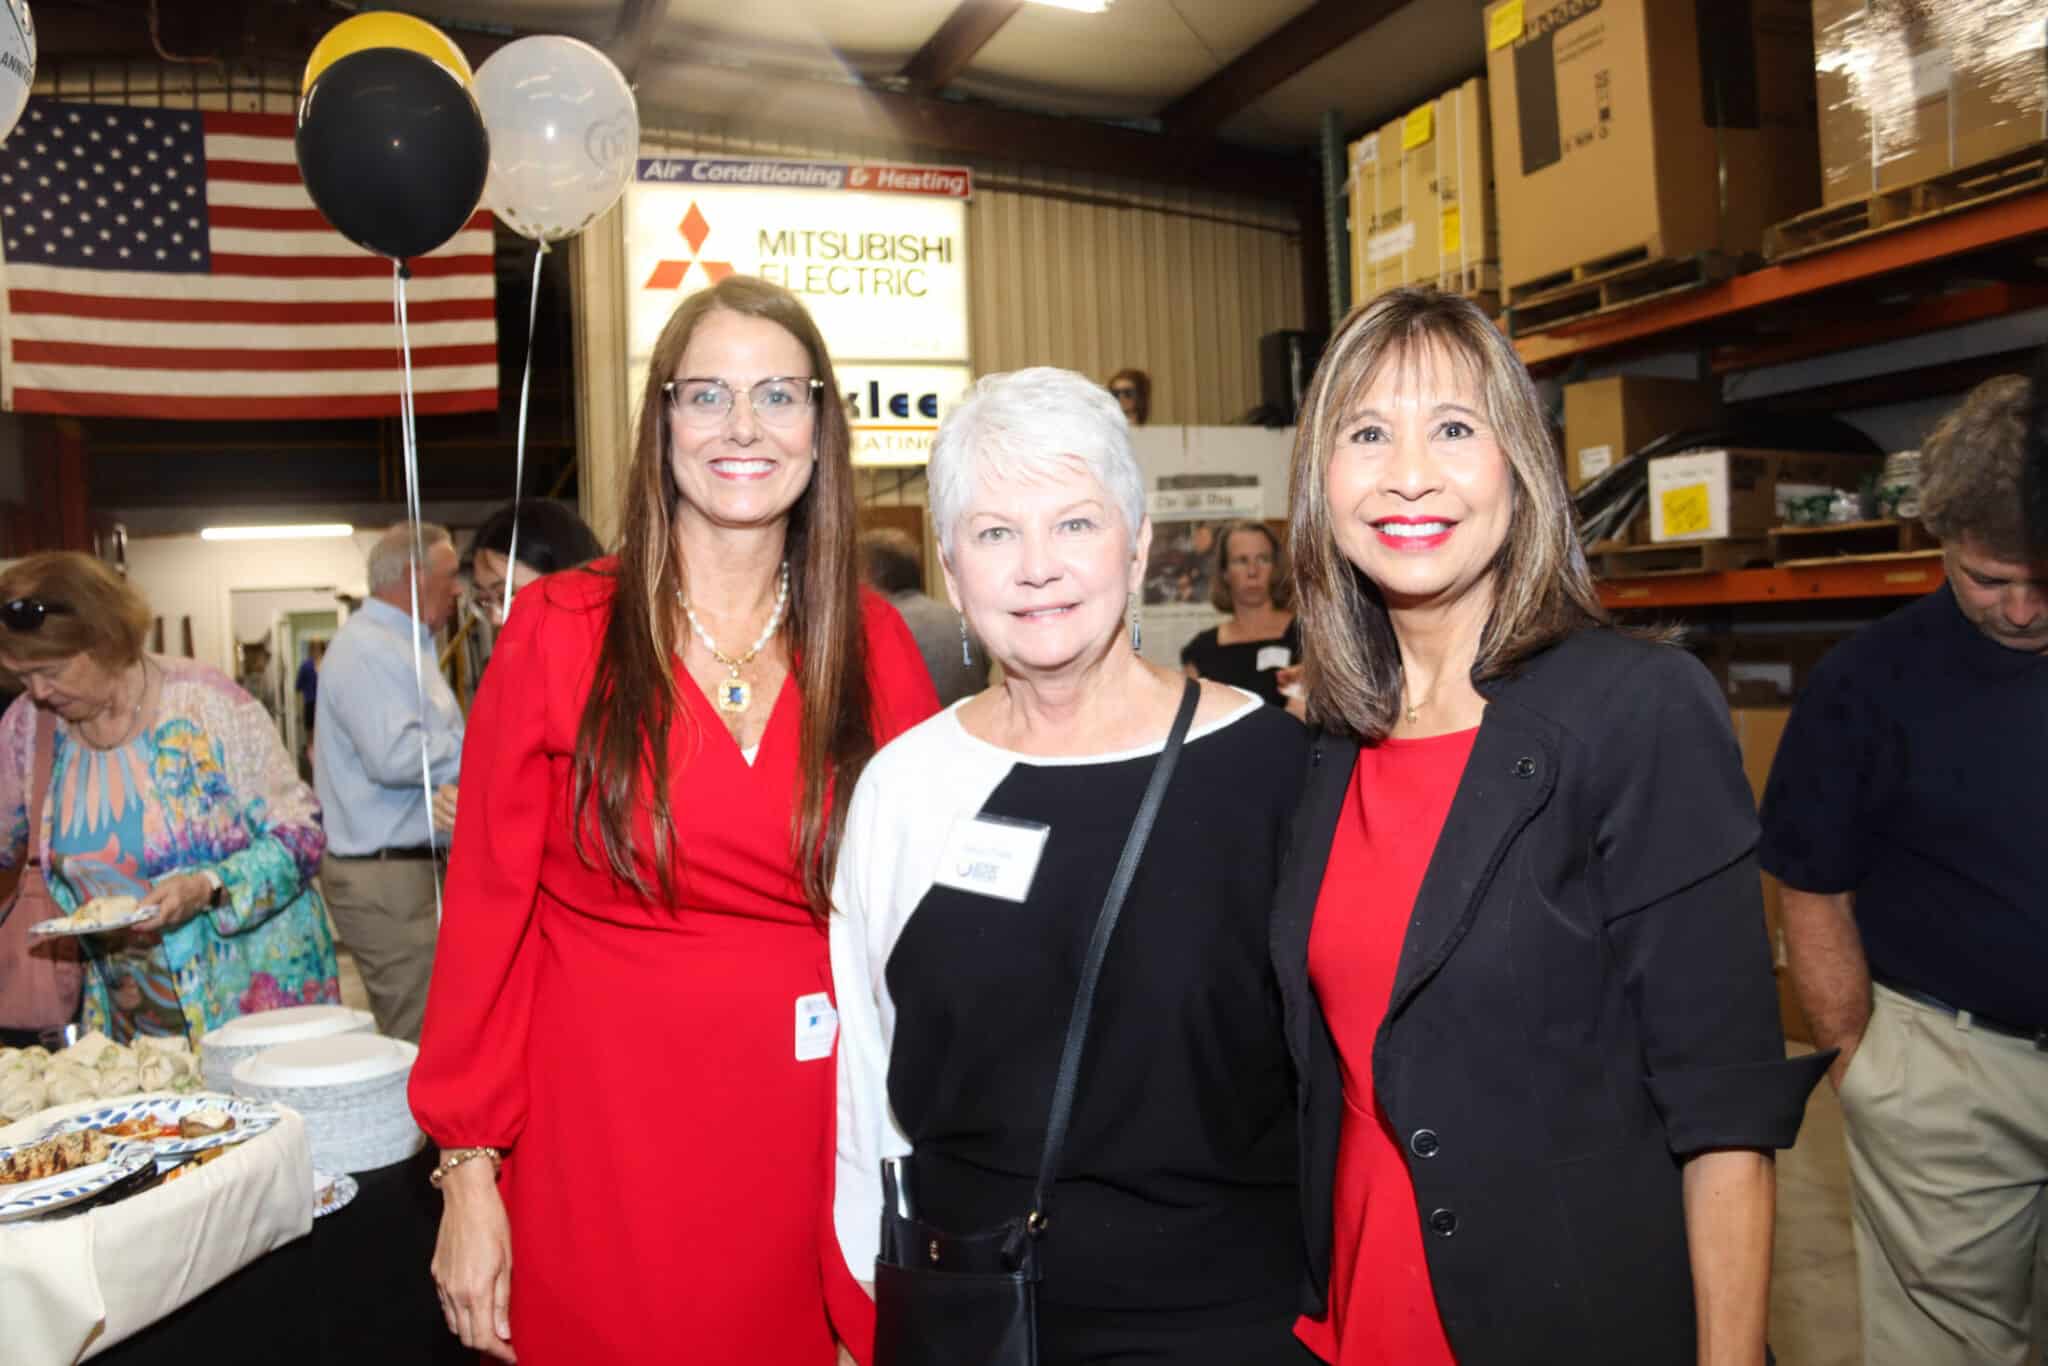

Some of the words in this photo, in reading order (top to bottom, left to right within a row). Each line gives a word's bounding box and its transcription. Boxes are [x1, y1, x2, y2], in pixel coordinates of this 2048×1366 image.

[643, 161, 684, 180] Air
[691, 161, 843, 188] Conditioning
[849, 169, 870, 187] &
[877, 168, 966, 194] Heating
[758, 229, 952, 263] MITSUBISHI
[759, 263, 928, 297] ELECTRIC
